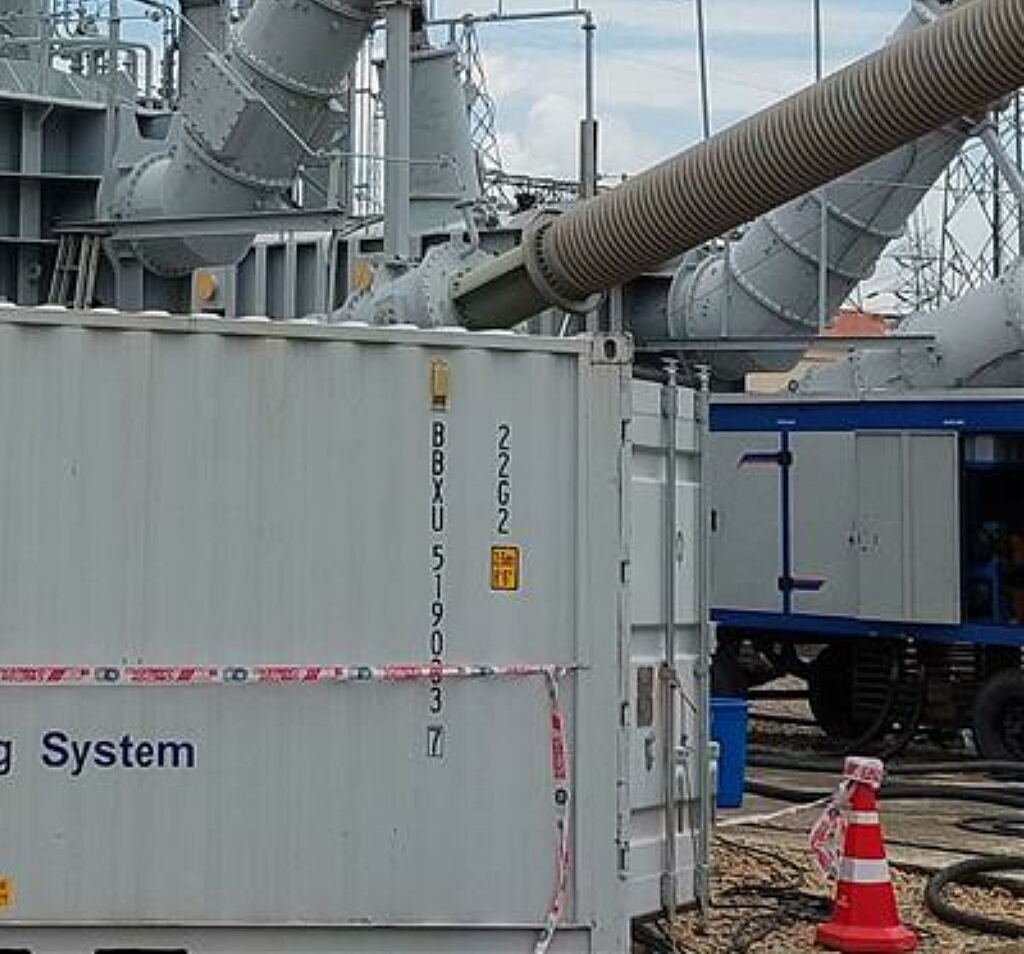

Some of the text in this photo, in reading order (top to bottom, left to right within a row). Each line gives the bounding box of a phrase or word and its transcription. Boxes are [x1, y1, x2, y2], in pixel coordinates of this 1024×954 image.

[432, 421, 444, 532] BBXU
[498, 424, 510, 535] 22G2
[41, 731, 195, 777] System
[428, 726, 443, 758] 7
